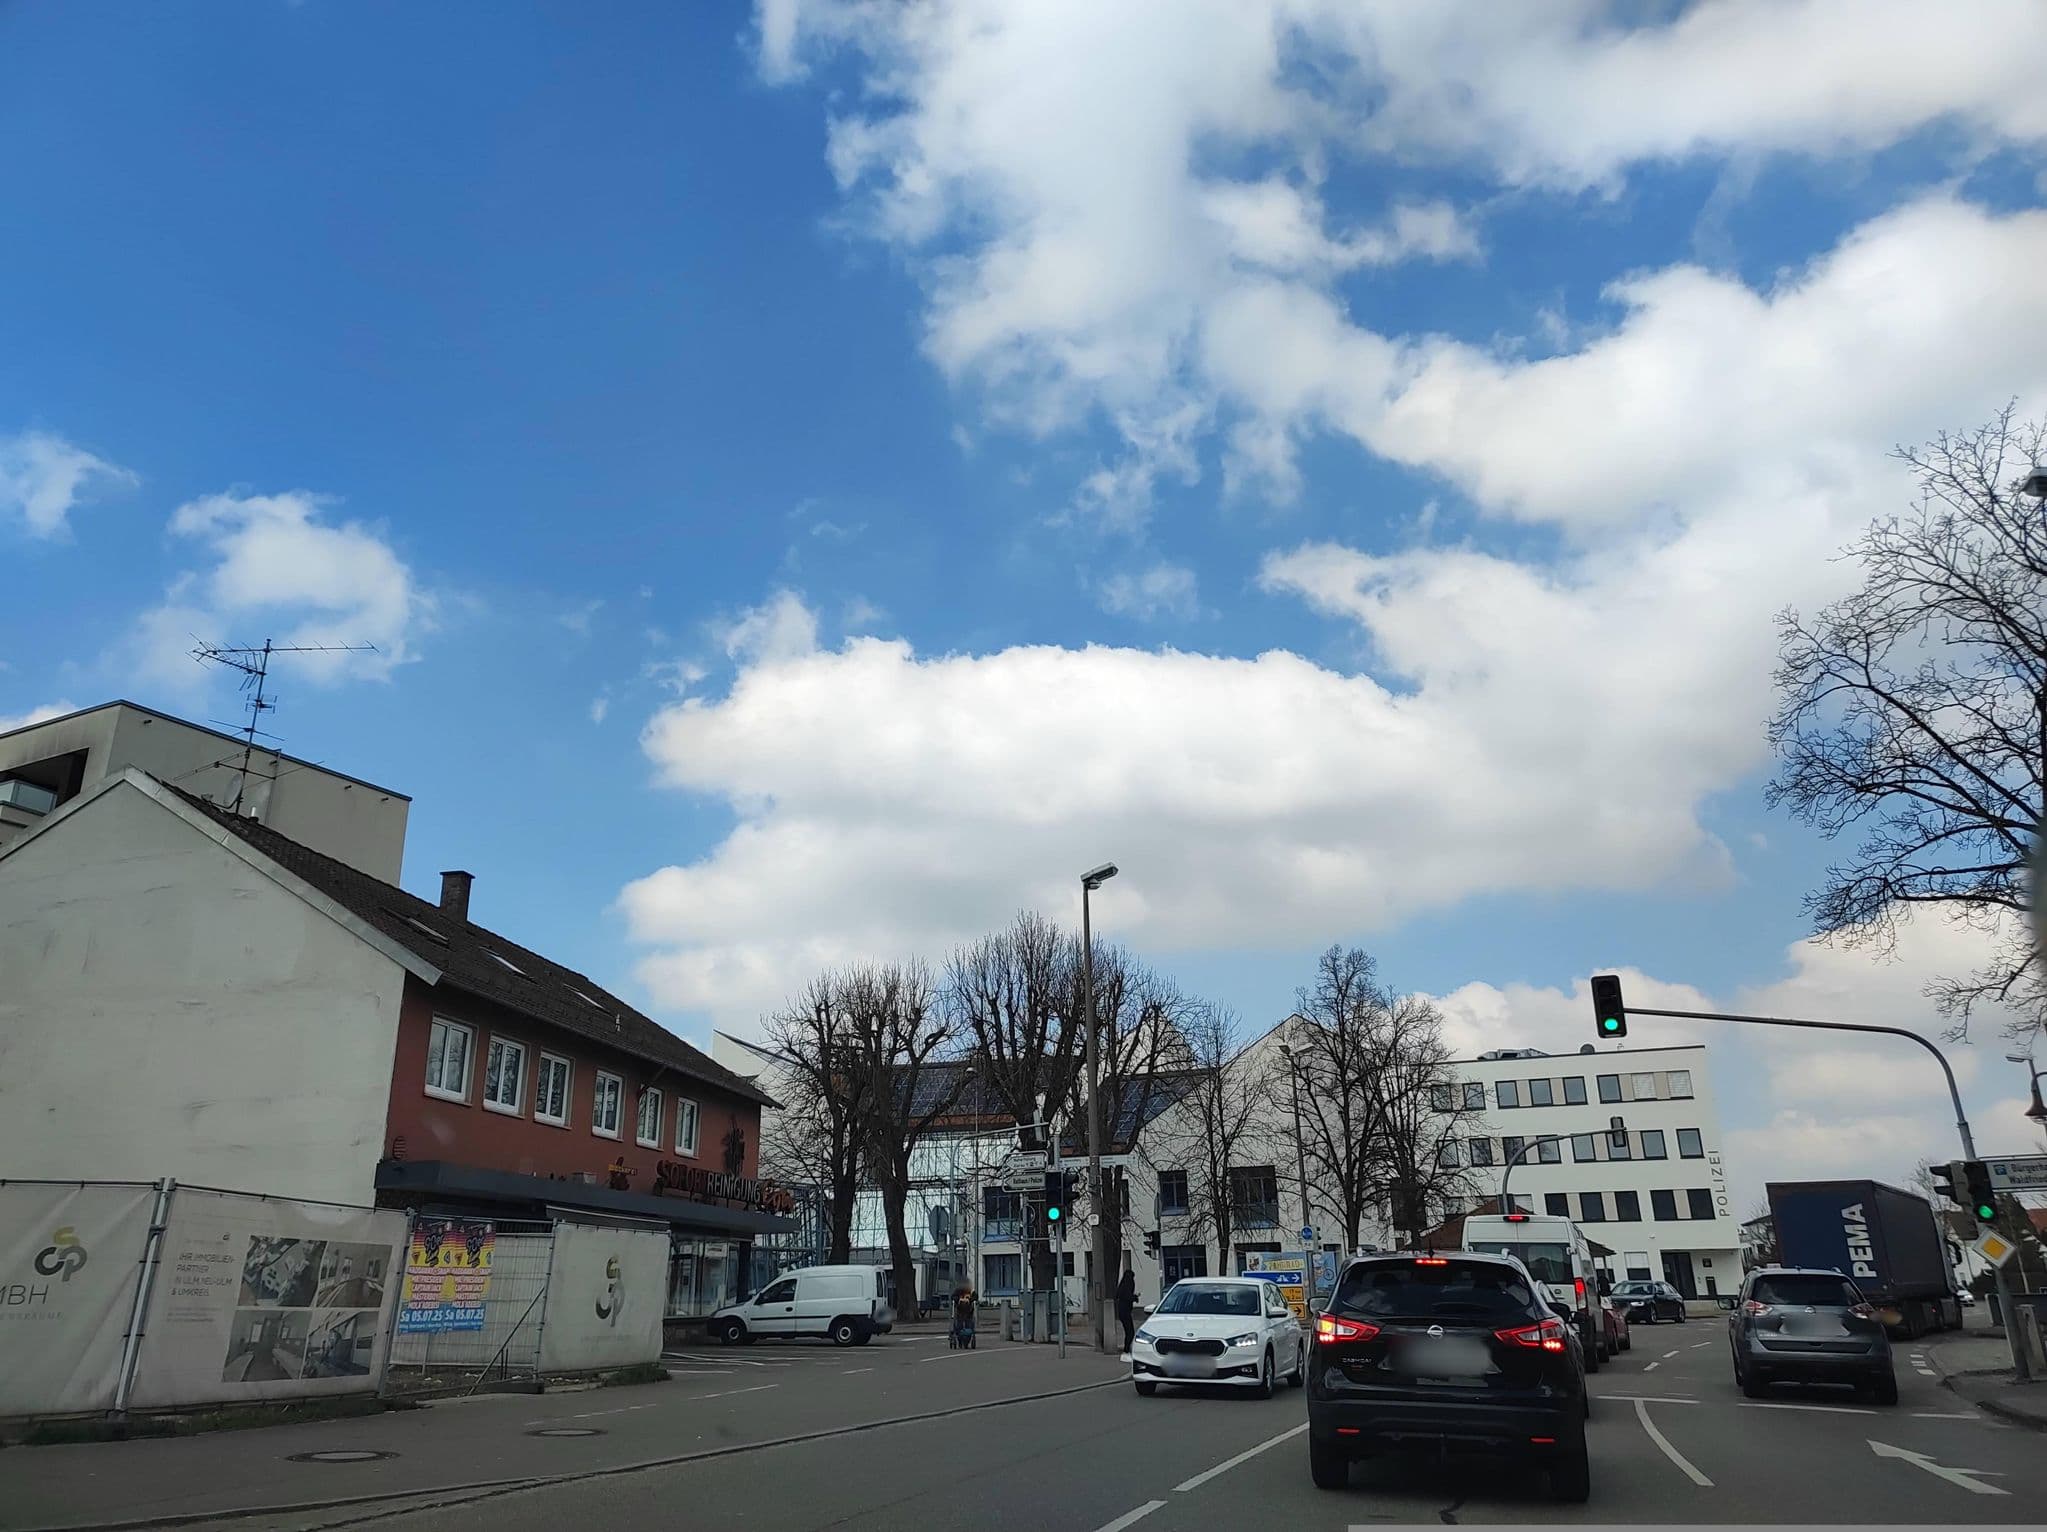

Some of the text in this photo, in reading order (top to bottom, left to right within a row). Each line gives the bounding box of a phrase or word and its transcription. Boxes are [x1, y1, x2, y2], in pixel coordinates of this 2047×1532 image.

[707, 1172, 760, 1205] REINIGUNG
[1707, 1150, 1731, 1217] POLIZEI
[1840, 1202, 1877, 1278] PEMA
[400, 1310, 443, 1322] Sa 05.07.25
[445, 1308, 485, 1320] Sa 05.07.25
